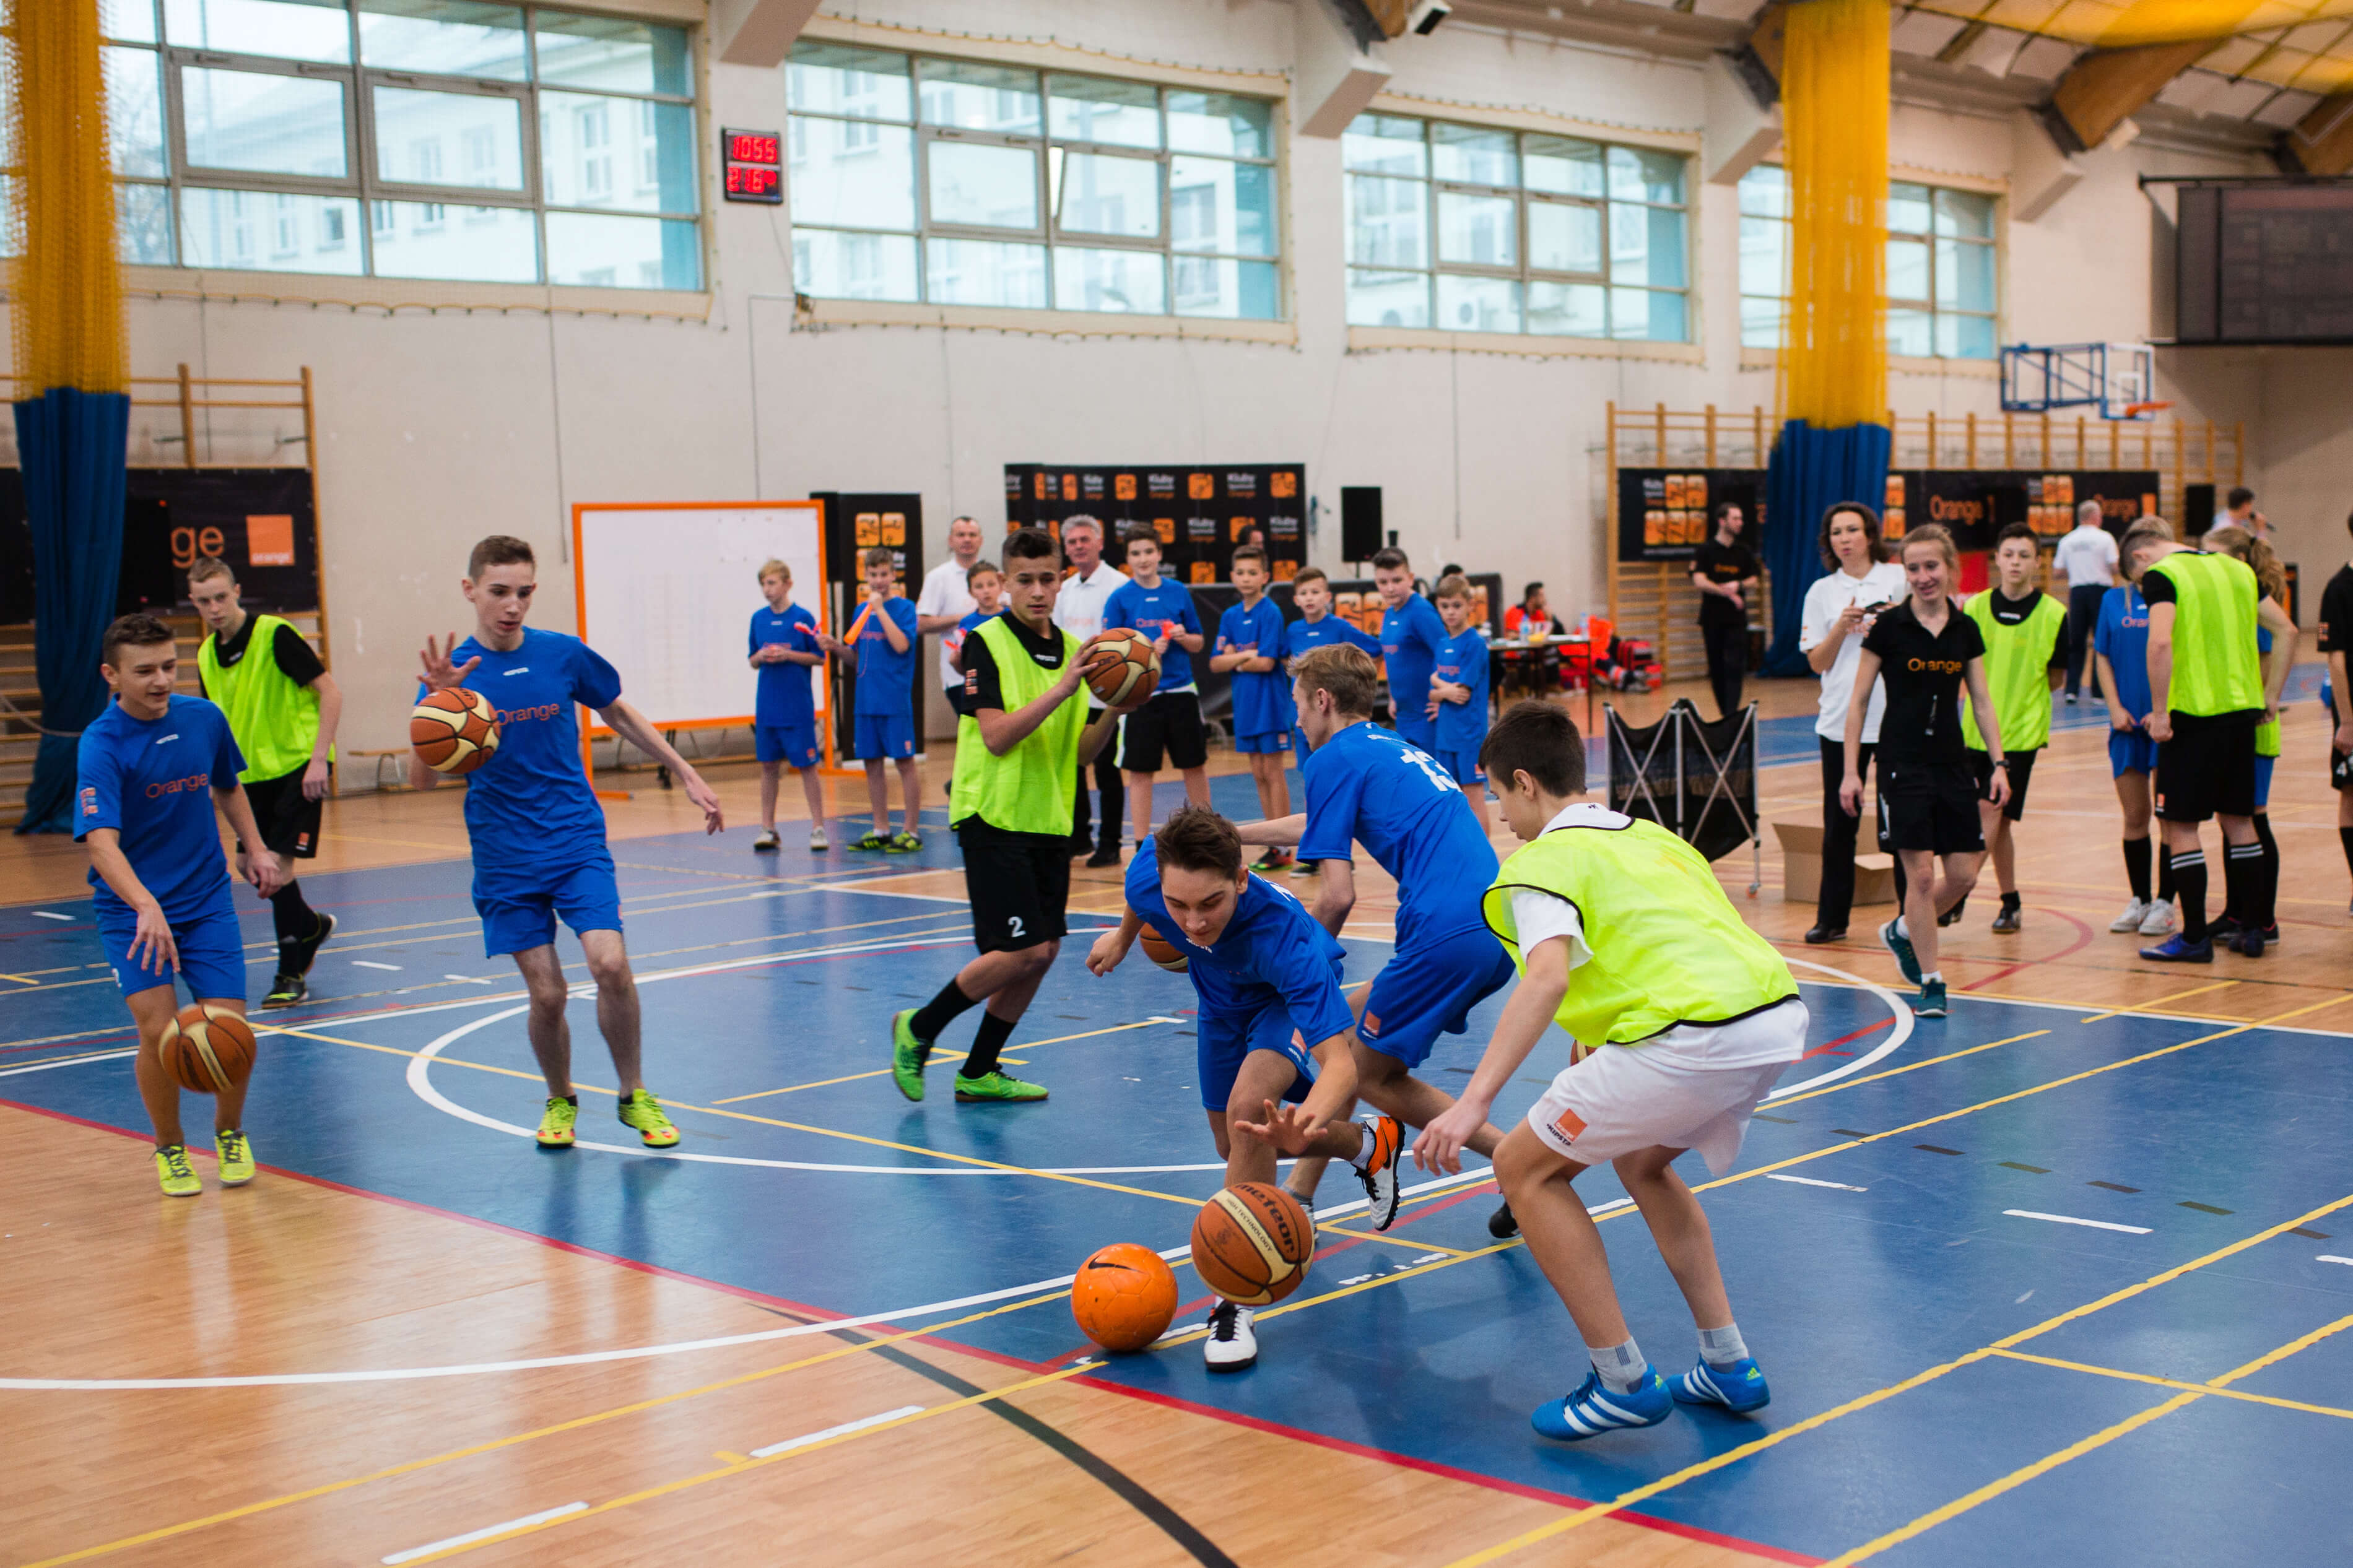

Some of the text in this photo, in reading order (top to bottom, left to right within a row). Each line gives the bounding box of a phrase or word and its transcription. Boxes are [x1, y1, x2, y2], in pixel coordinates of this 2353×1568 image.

[1929, 495, 1983, 526] Orange
[1908, 658, 1962, 674] Orange
[496, 703, 560, 726] Orange
[146, 773, 209, 798] Orange
[1008, 916, 1026, 937] 2
